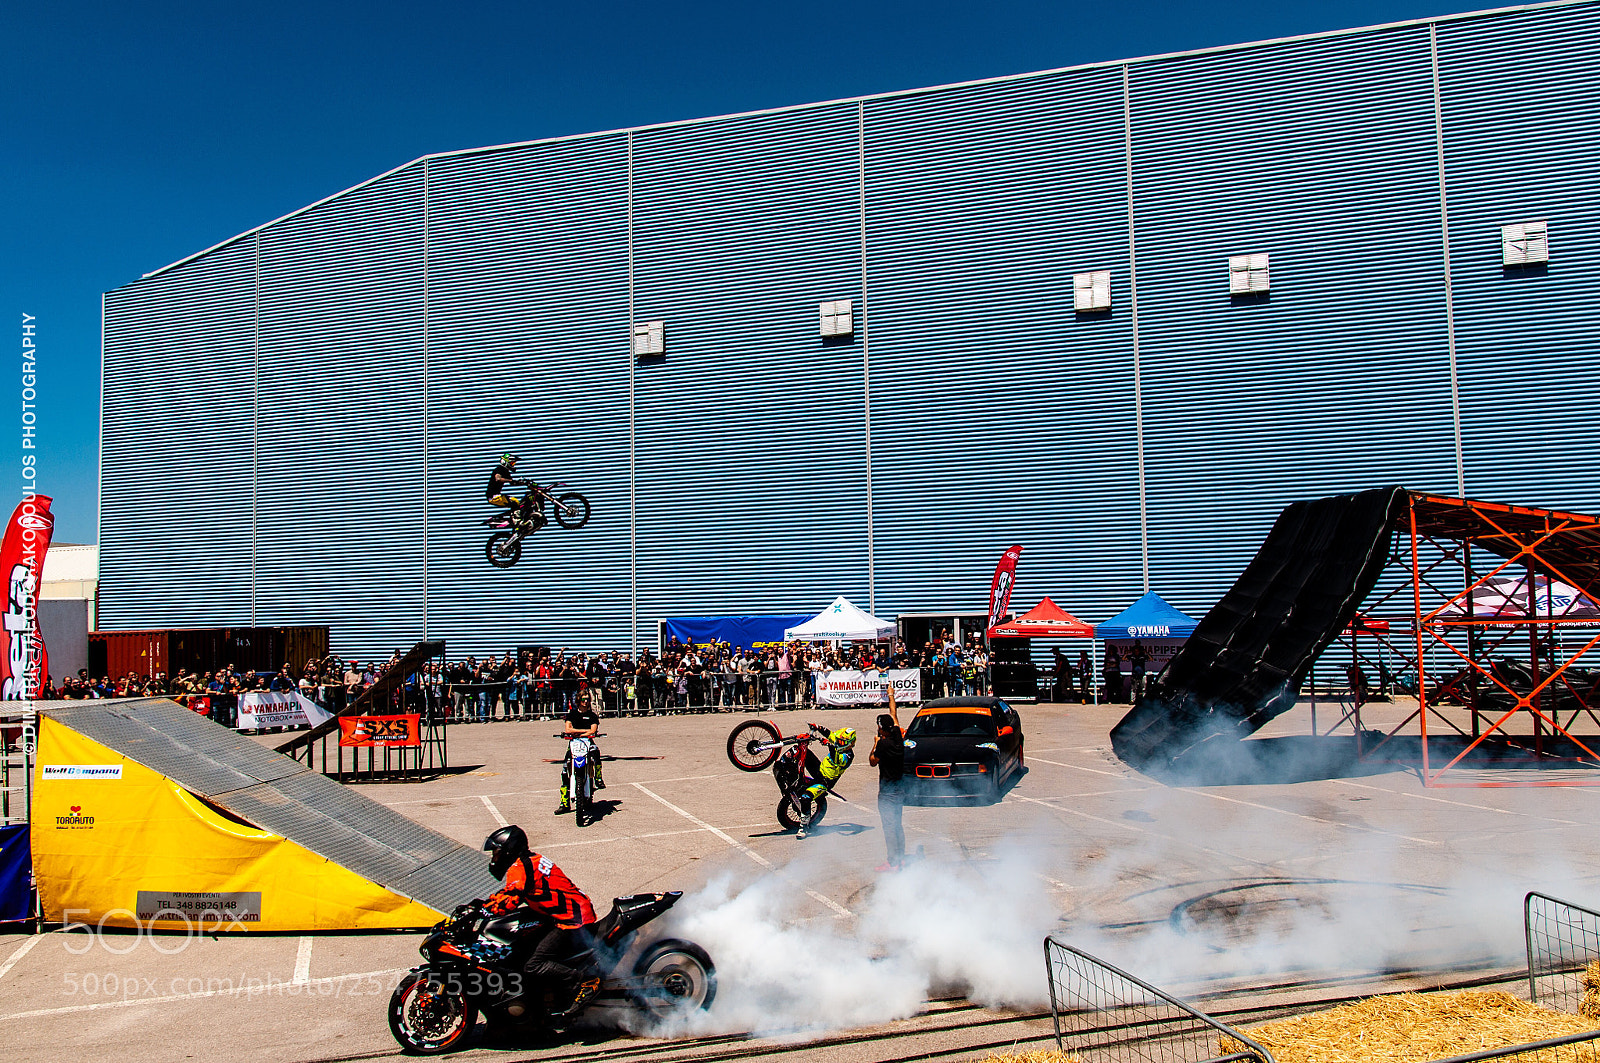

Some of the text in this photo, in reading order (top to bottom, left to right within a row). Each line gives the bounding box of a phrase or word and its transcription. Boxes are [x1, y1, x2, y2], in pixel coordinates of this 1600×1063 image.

[1136, 625, 1170, 635] YAMAHA
[828, 679, 918, 691] YAMAHAPIPEIGOS
[364, 719, 408, 736] SXS
[56, 816, 95, 825] TOROAUTO
[157, 900, 237, 910] TEL. 348 8826148
